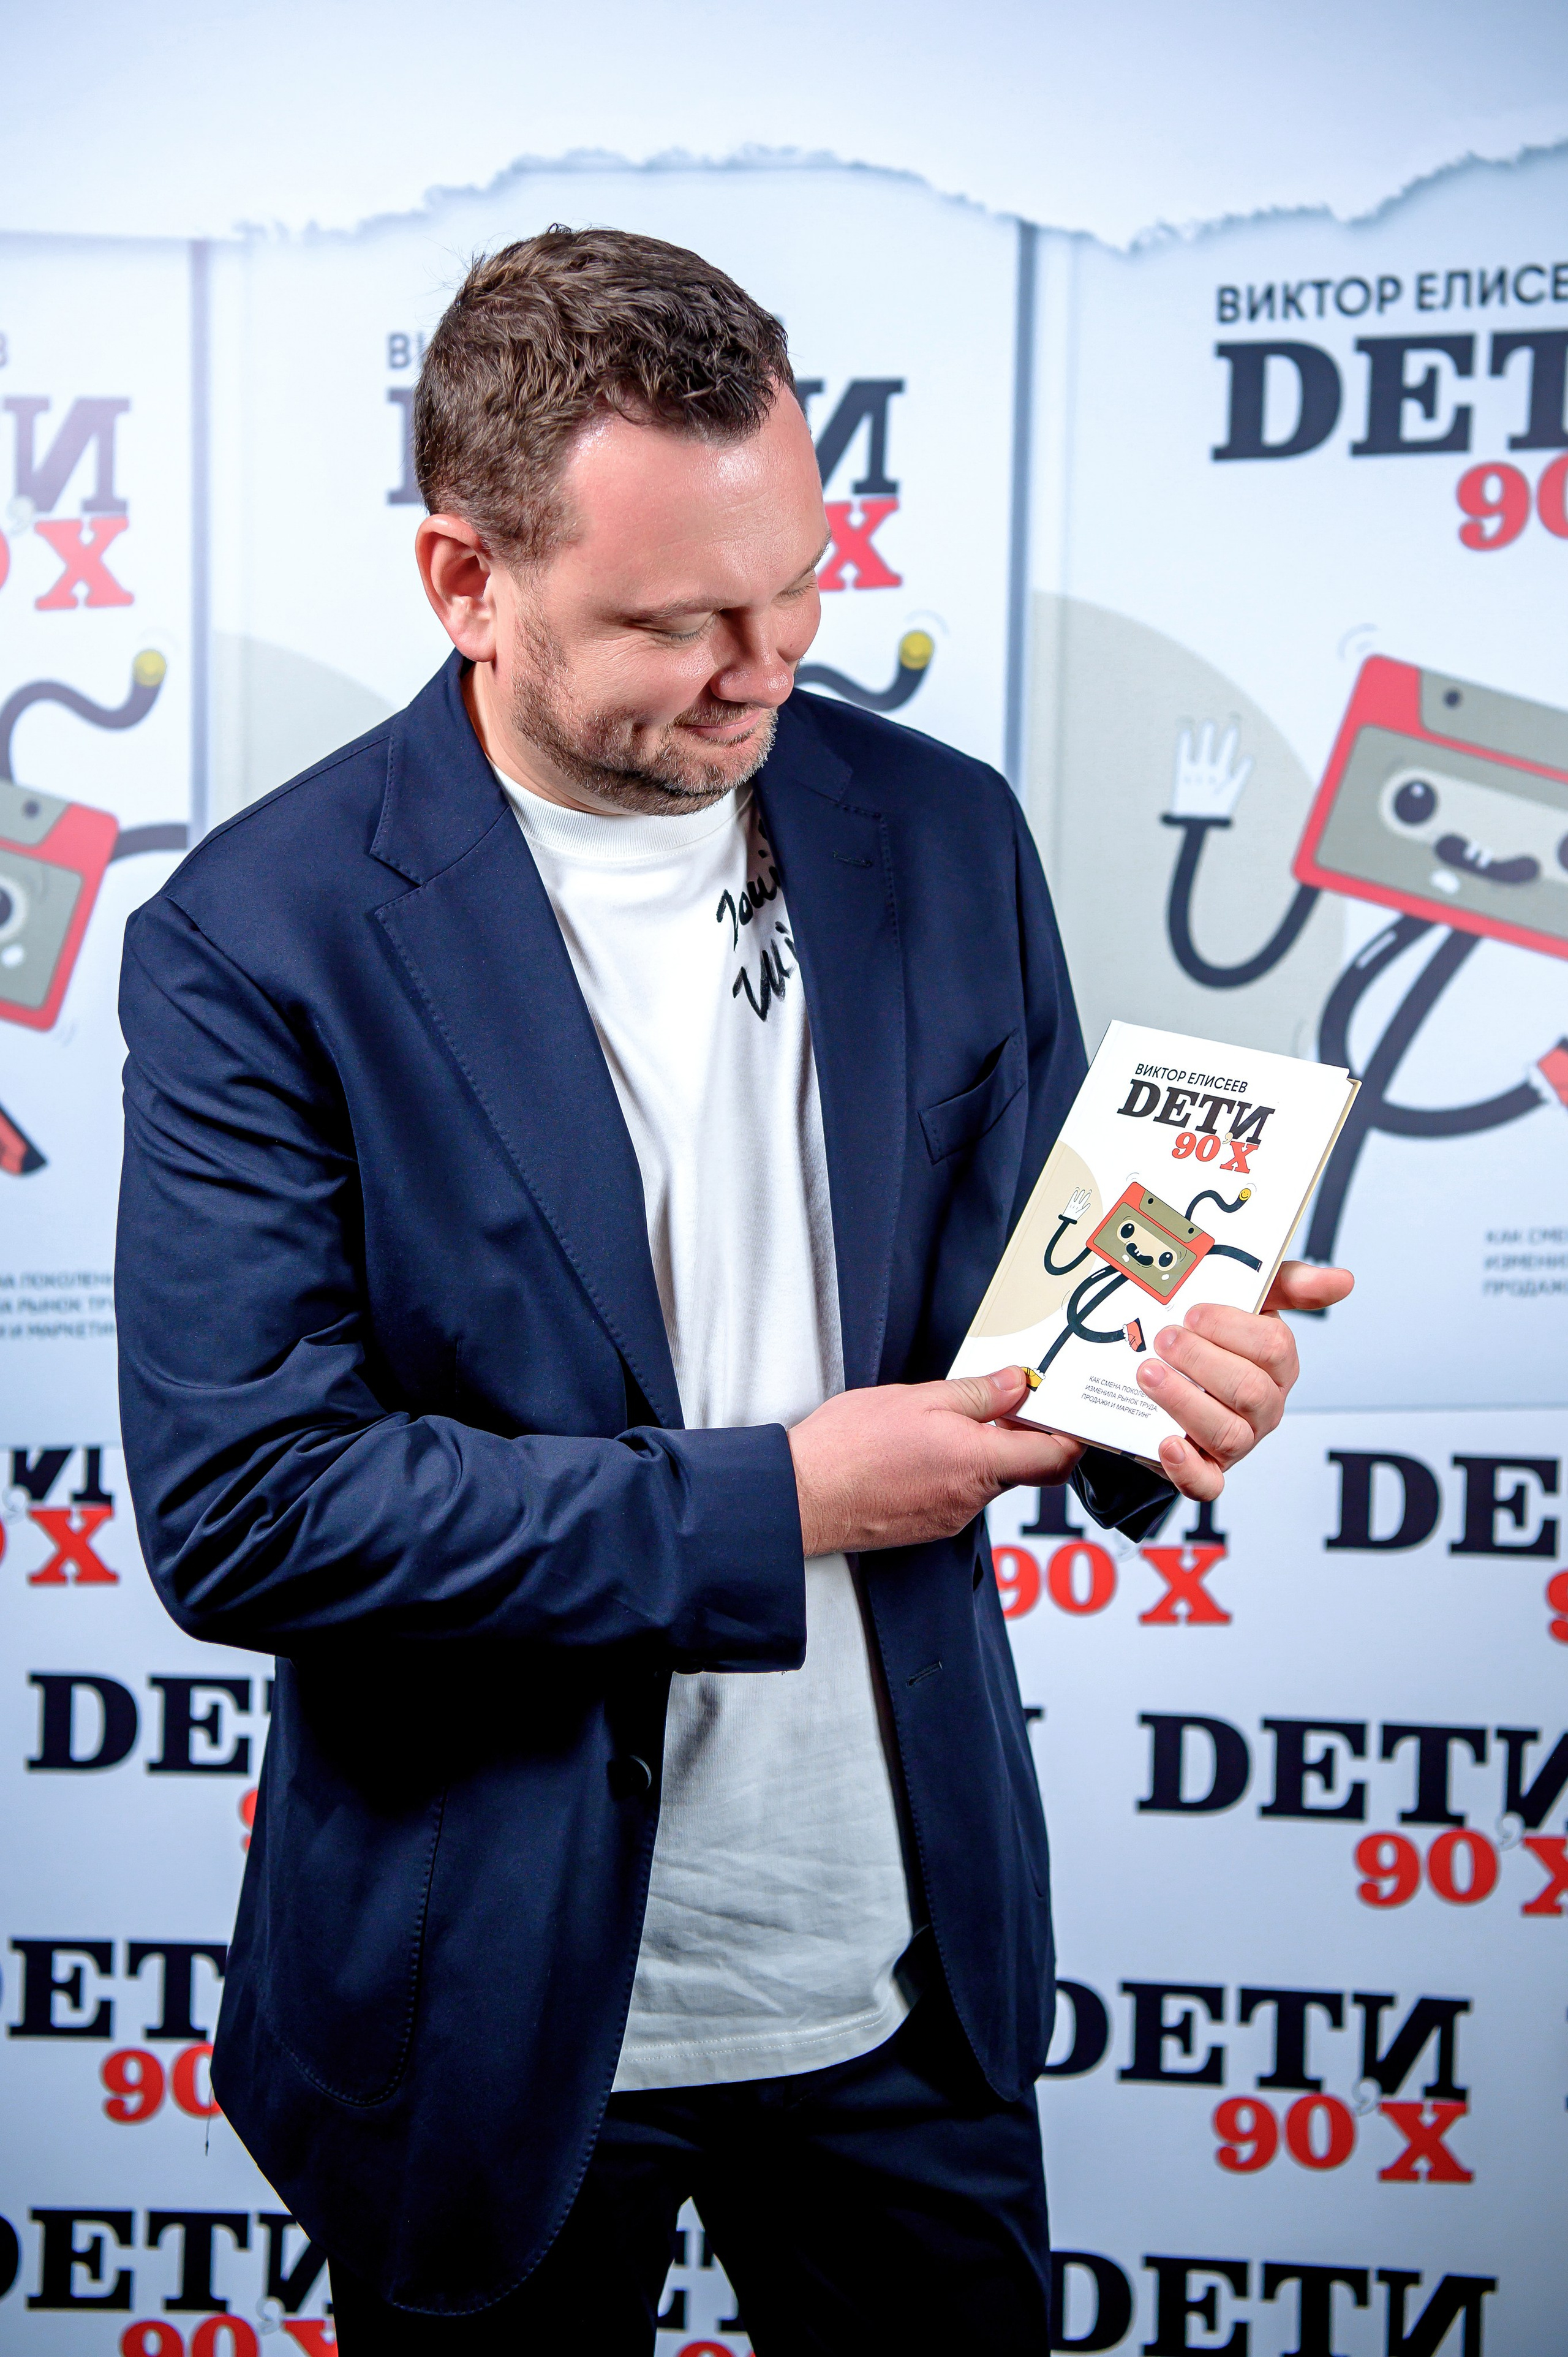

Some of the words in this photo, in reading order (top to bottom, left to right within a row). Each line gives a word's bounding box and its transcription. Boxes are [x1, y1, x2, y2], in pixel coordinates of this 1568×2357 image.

[1216, 274, 1404, 326] ВИКТОР
[1135, 1063, 1186, 1082] ВИКТОР
[1188, 1073, 1248, 1093] ЕЛИСЕЕВ
[1085, 1384, 1116, 1399] ИЗМЕНИЛА
[1117, 1394, 1137, 1405] РЫНОК
[1101, 1379, 1121, 1390] СМЕНА
[1081, 1393, 1110, 1406] ПРОДАЖИ
[1116, 1404, 1151, 1419] МАРКЕТИНГ
